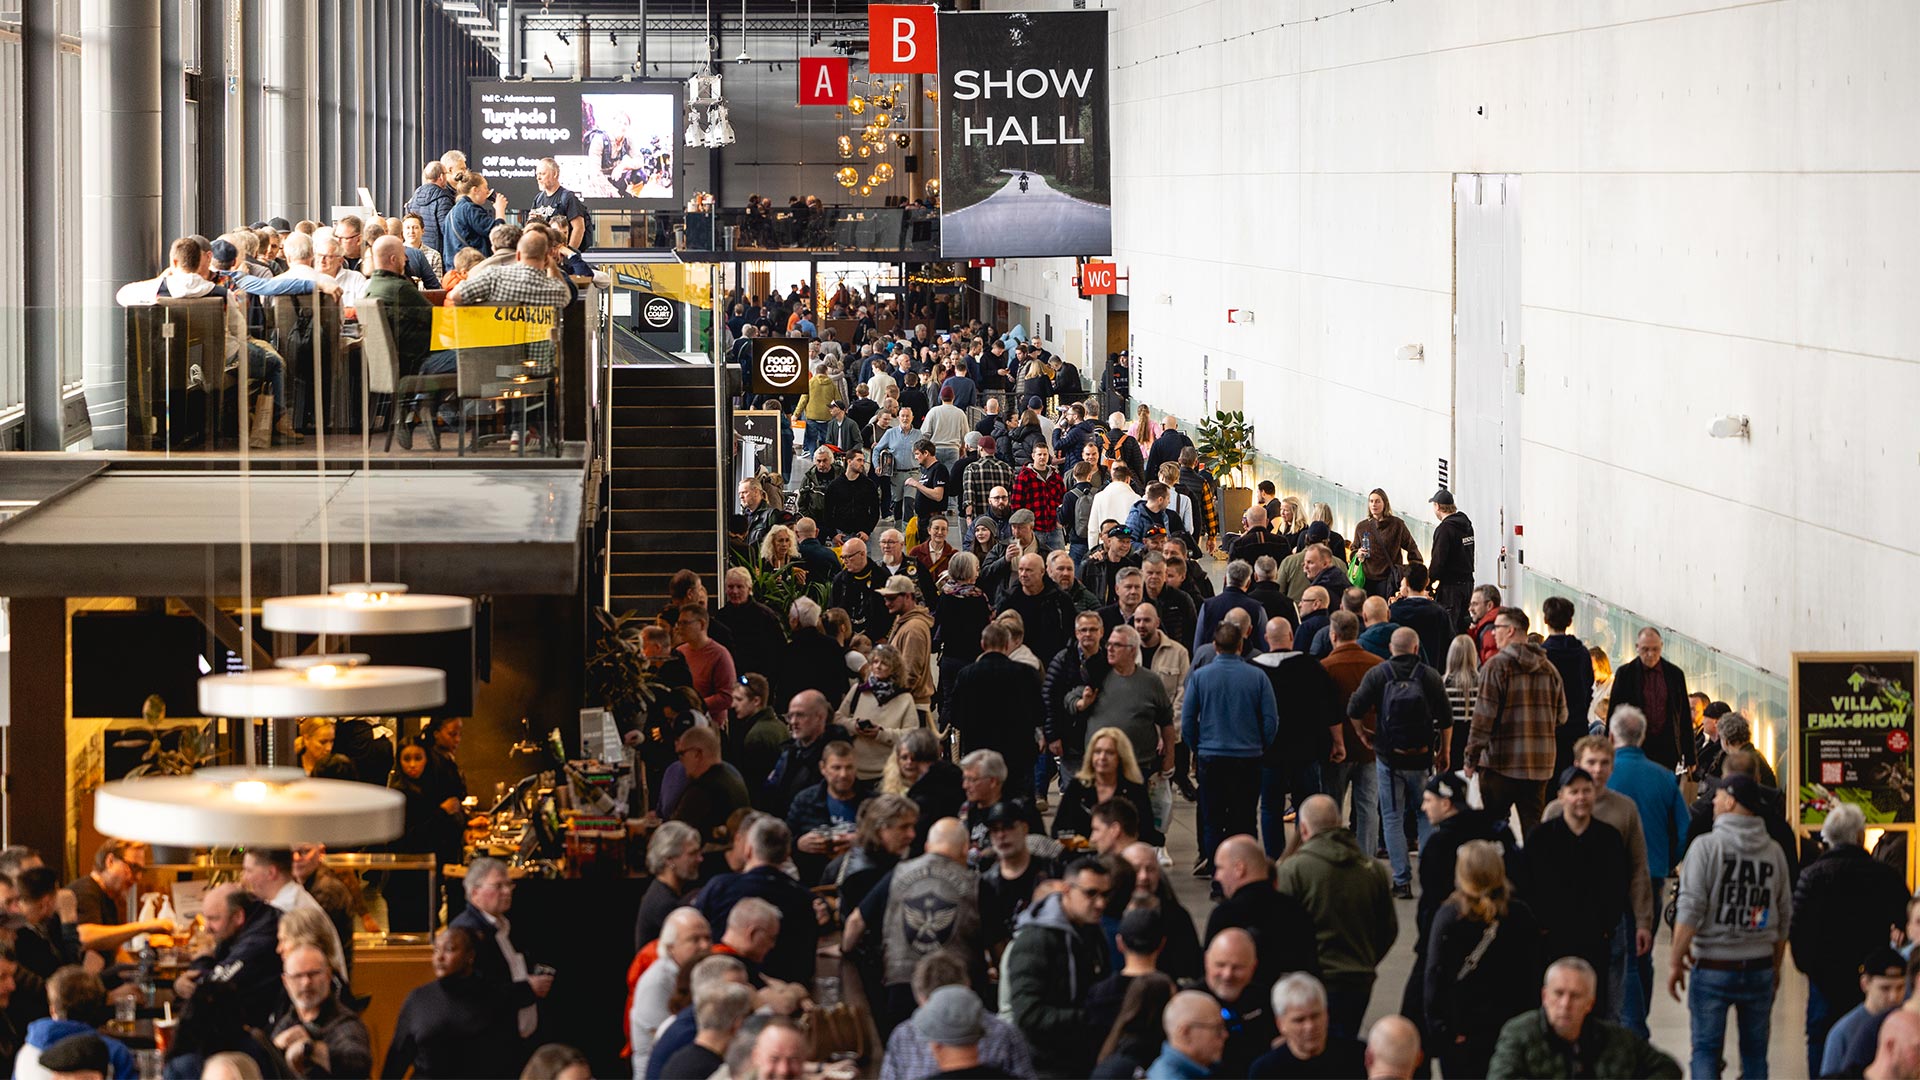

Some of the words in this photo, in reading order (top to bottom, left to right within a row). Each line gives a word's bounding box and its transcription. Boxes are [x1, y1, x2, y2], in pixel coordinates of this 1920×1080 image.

[891, 17, 917, 63] B
[813, 65, 834, 98] A
[953, 68, 1094, 100] SHOW
[481, 107, 548, 128] Turglede
[550, 108, 556, 124] i
[481, 126, 518, 144] eget
[520, 126, 571, 144] tempo
[964, 115, 1085, 146] HALL
[1087, 270, 1111, 288] WC
[765, 365, 796, 373] COURT
[767, 356, 795, 365] FOOD
[1831, 696, 1883, 711] VILLA
[1807, 713, 1907, 729] FMX-SHOW
[1721, 859, 1773, 887] ZAP
